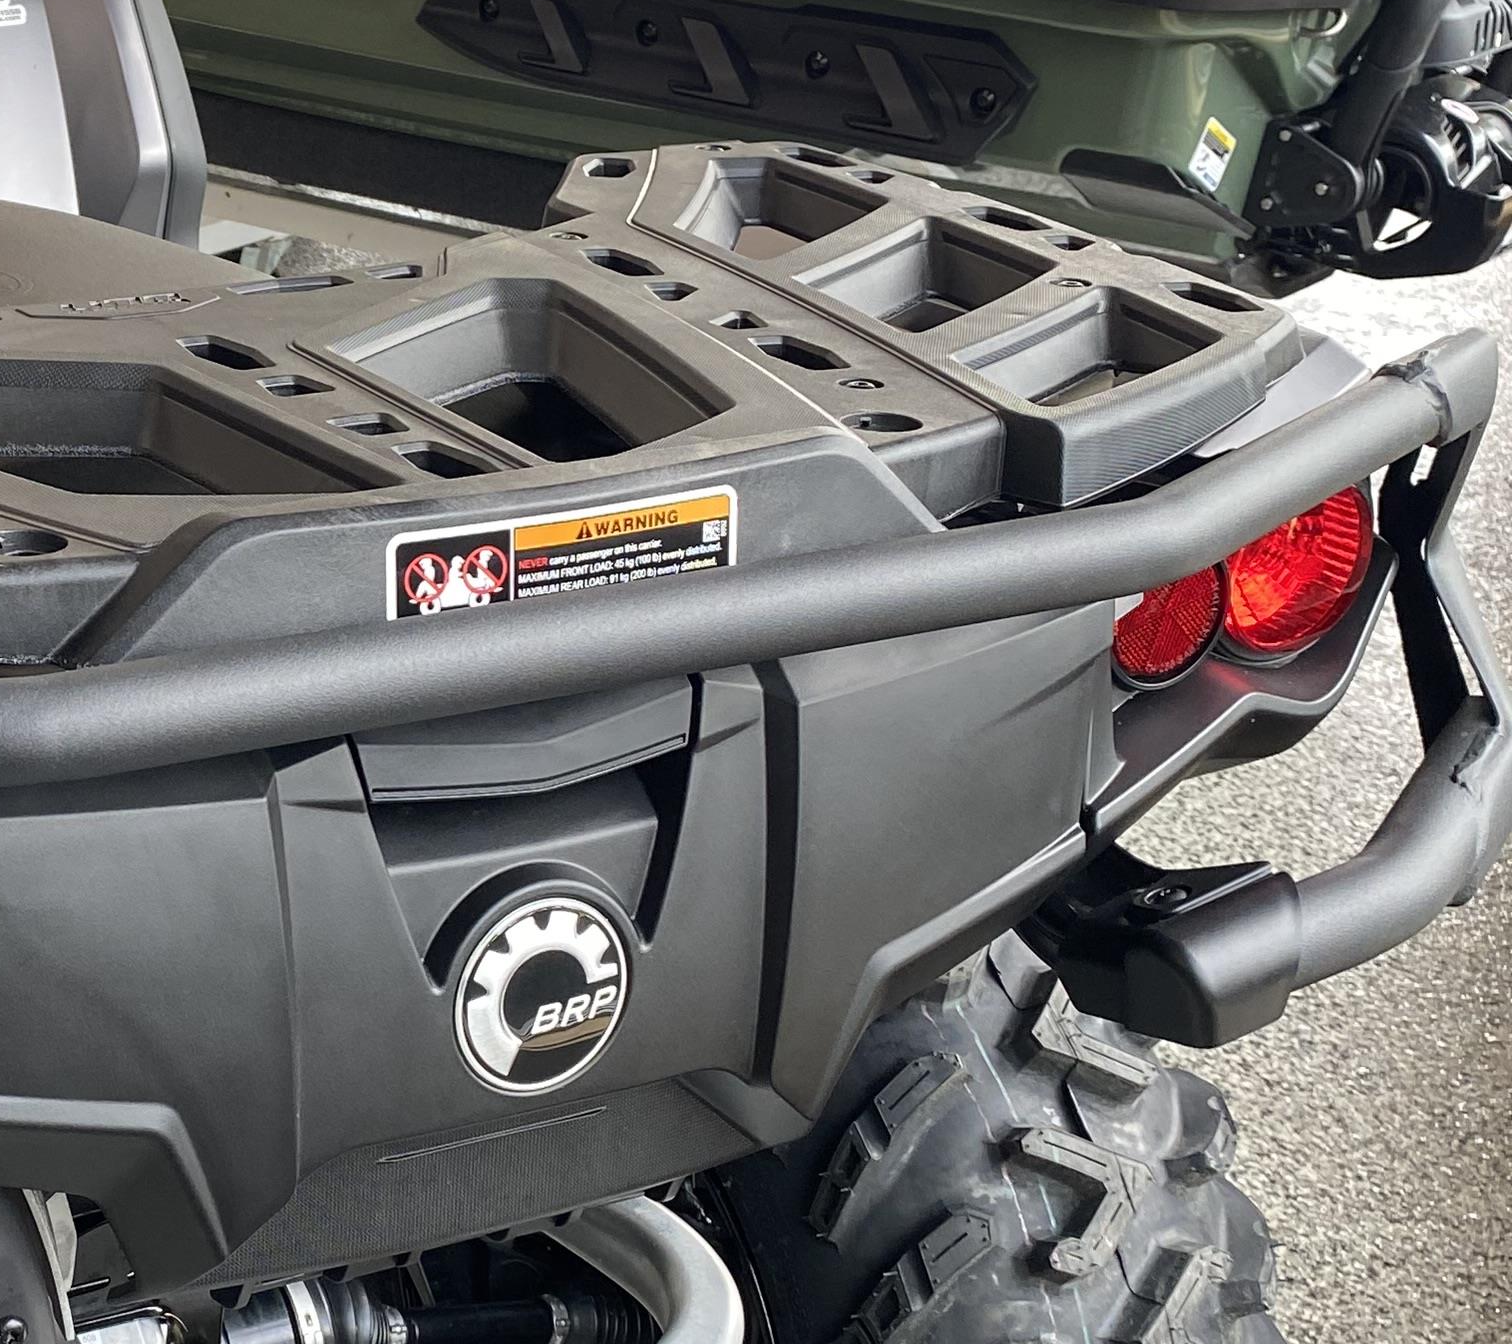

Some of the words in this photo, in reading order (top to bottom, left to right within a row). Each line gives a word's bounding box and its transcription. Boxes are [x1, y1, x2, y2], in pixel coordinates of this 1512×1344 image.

[594, 510, 678, 536] WARNING
[518, 570, 560, 584] MAXIMUM
[560, 564, 589, 578] FRONT
[589, 561, 613, 573] LOAD:
[614, 559, 625, 569] 45
[625, 558, 634, 568] kg
[636, 553, 651, 567] (100
[652, 552, 662, 563] lb)
[662, 548, 685, 560] evenly
[686, 542, 723, 557] distributed.
[519, 557, 548, 569] NEVER
[549, 555, 569, 566] carry
[577, 548, 614, 563] passenger
[614, 546, 624, 555] on
[625, 543, 637, 553] this
[639, 538, 663, 551] carrier.
[518, 584, 560, 598] MAXIMUM
[560, 580, 584, 592] REAR
[584, 576, 608, 588] LOAD:
[619, 573, 629, 583] kg
[630, 568, 647, 581] (200
[647, 567, 657, 578] lb)
[657, 563, 680, 576] evenly
[681, 556, 718, 571] distributed.
[531, 985, 618, 1035] BRP
